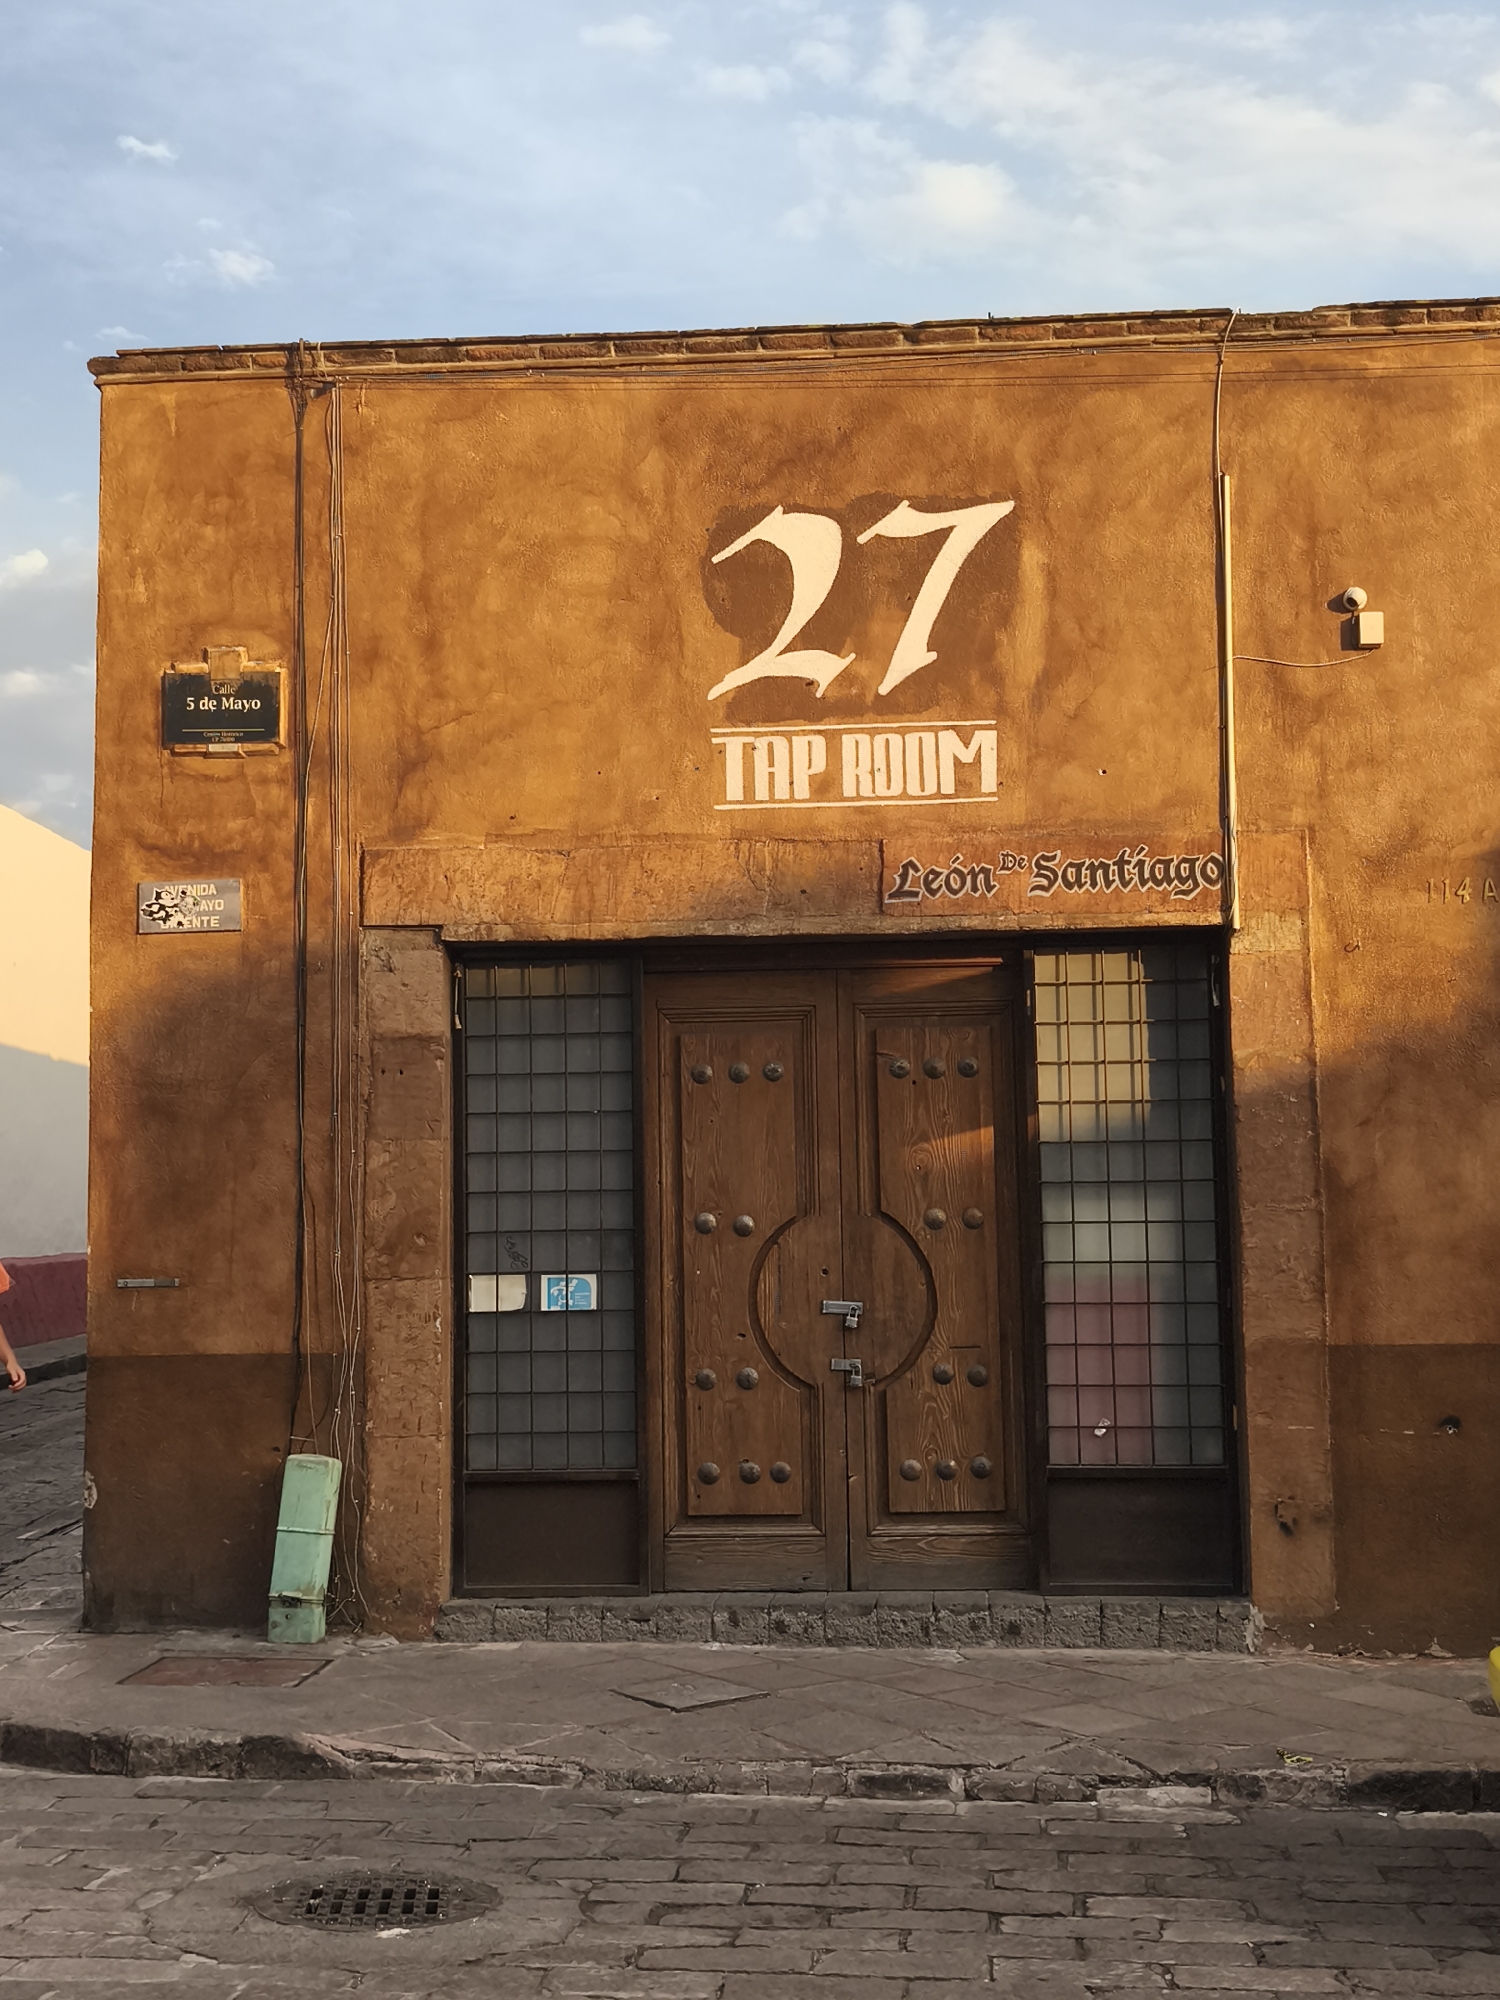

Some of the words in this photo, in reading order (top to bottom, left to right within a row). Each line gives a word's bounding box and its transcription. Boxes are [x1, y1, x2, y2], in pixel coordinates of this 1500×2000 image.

[707, 499, 1015, 701] 27
[186, 697, 195, 710] 5
[200, 697, 217, 711] de
[221, 697, 261, 712] Mayo
[213, 684, 236, 694] Calle
[711, 735, 827, 801] TAP
[841, 729, 998, 798] ROOM
[885, 853, 999, 903] León
[997, 850, 1028, 875] De
[195, 899, 224, 912] AYO
